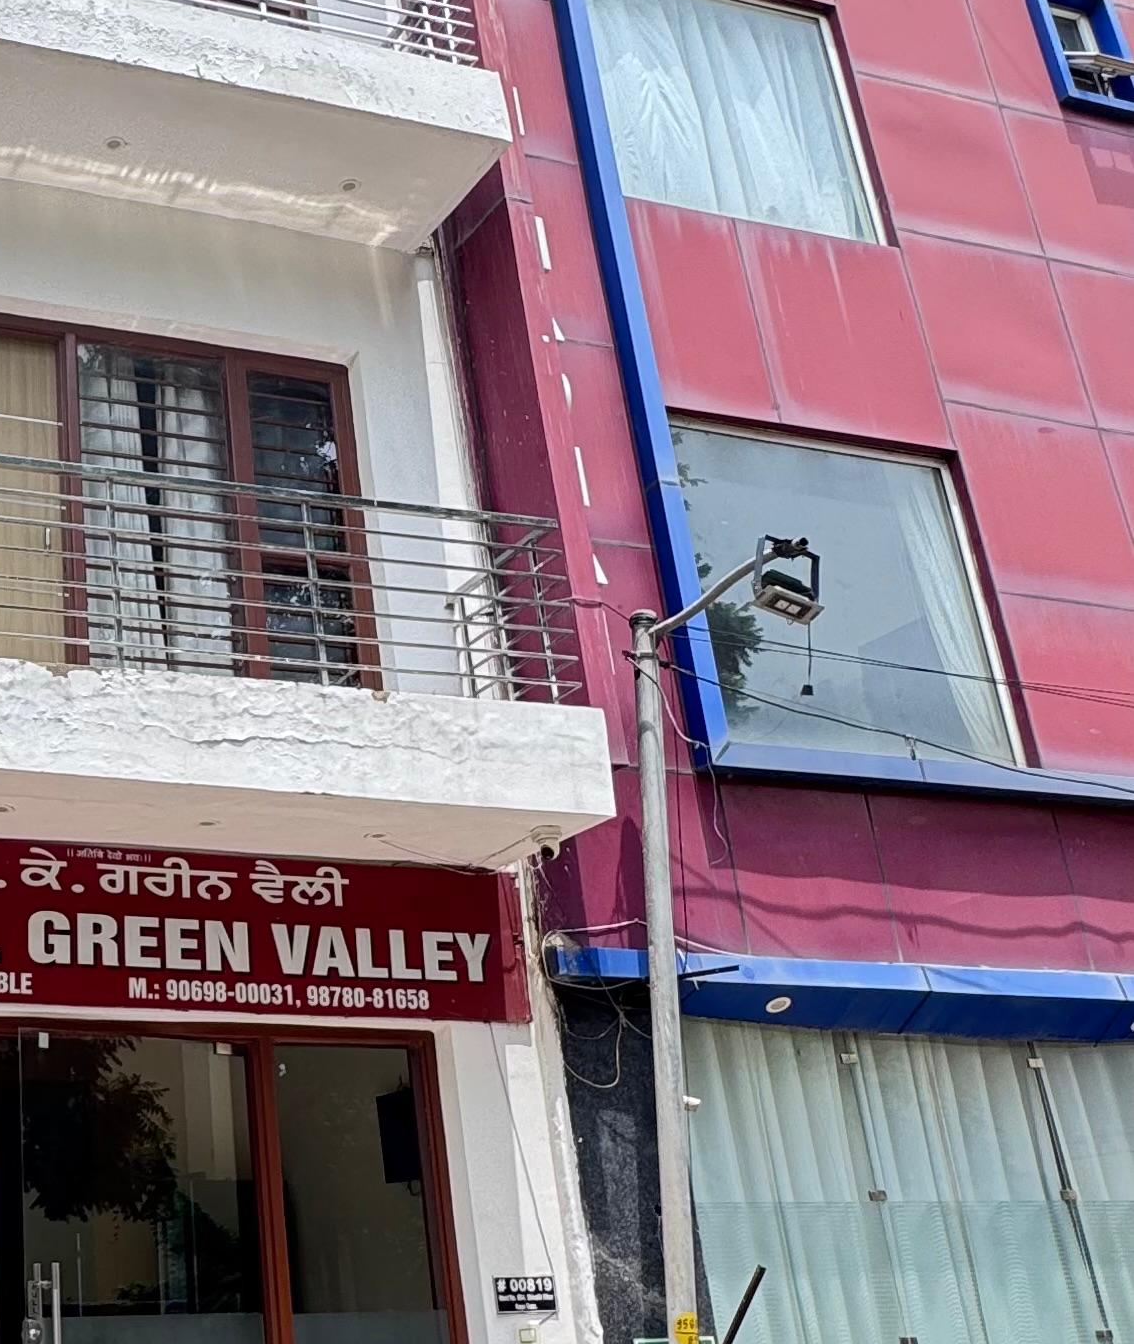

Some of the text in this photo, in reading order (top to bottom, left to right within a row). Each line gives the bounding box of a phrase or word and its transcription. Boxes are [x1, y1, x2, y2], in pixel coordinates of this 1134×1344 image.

[95, 855, 239, 901] ਗਰੀਨ
[248, 859, 350, 907] ਵੈਲੀ
[27, 910, 251, 973] GREEN
[270, 922, 491, 983] VALLEY
[127, 976, 430, 1011] M.: 90698-00031, 98780-81658
[509, 1277, 553, 1292] 00819
